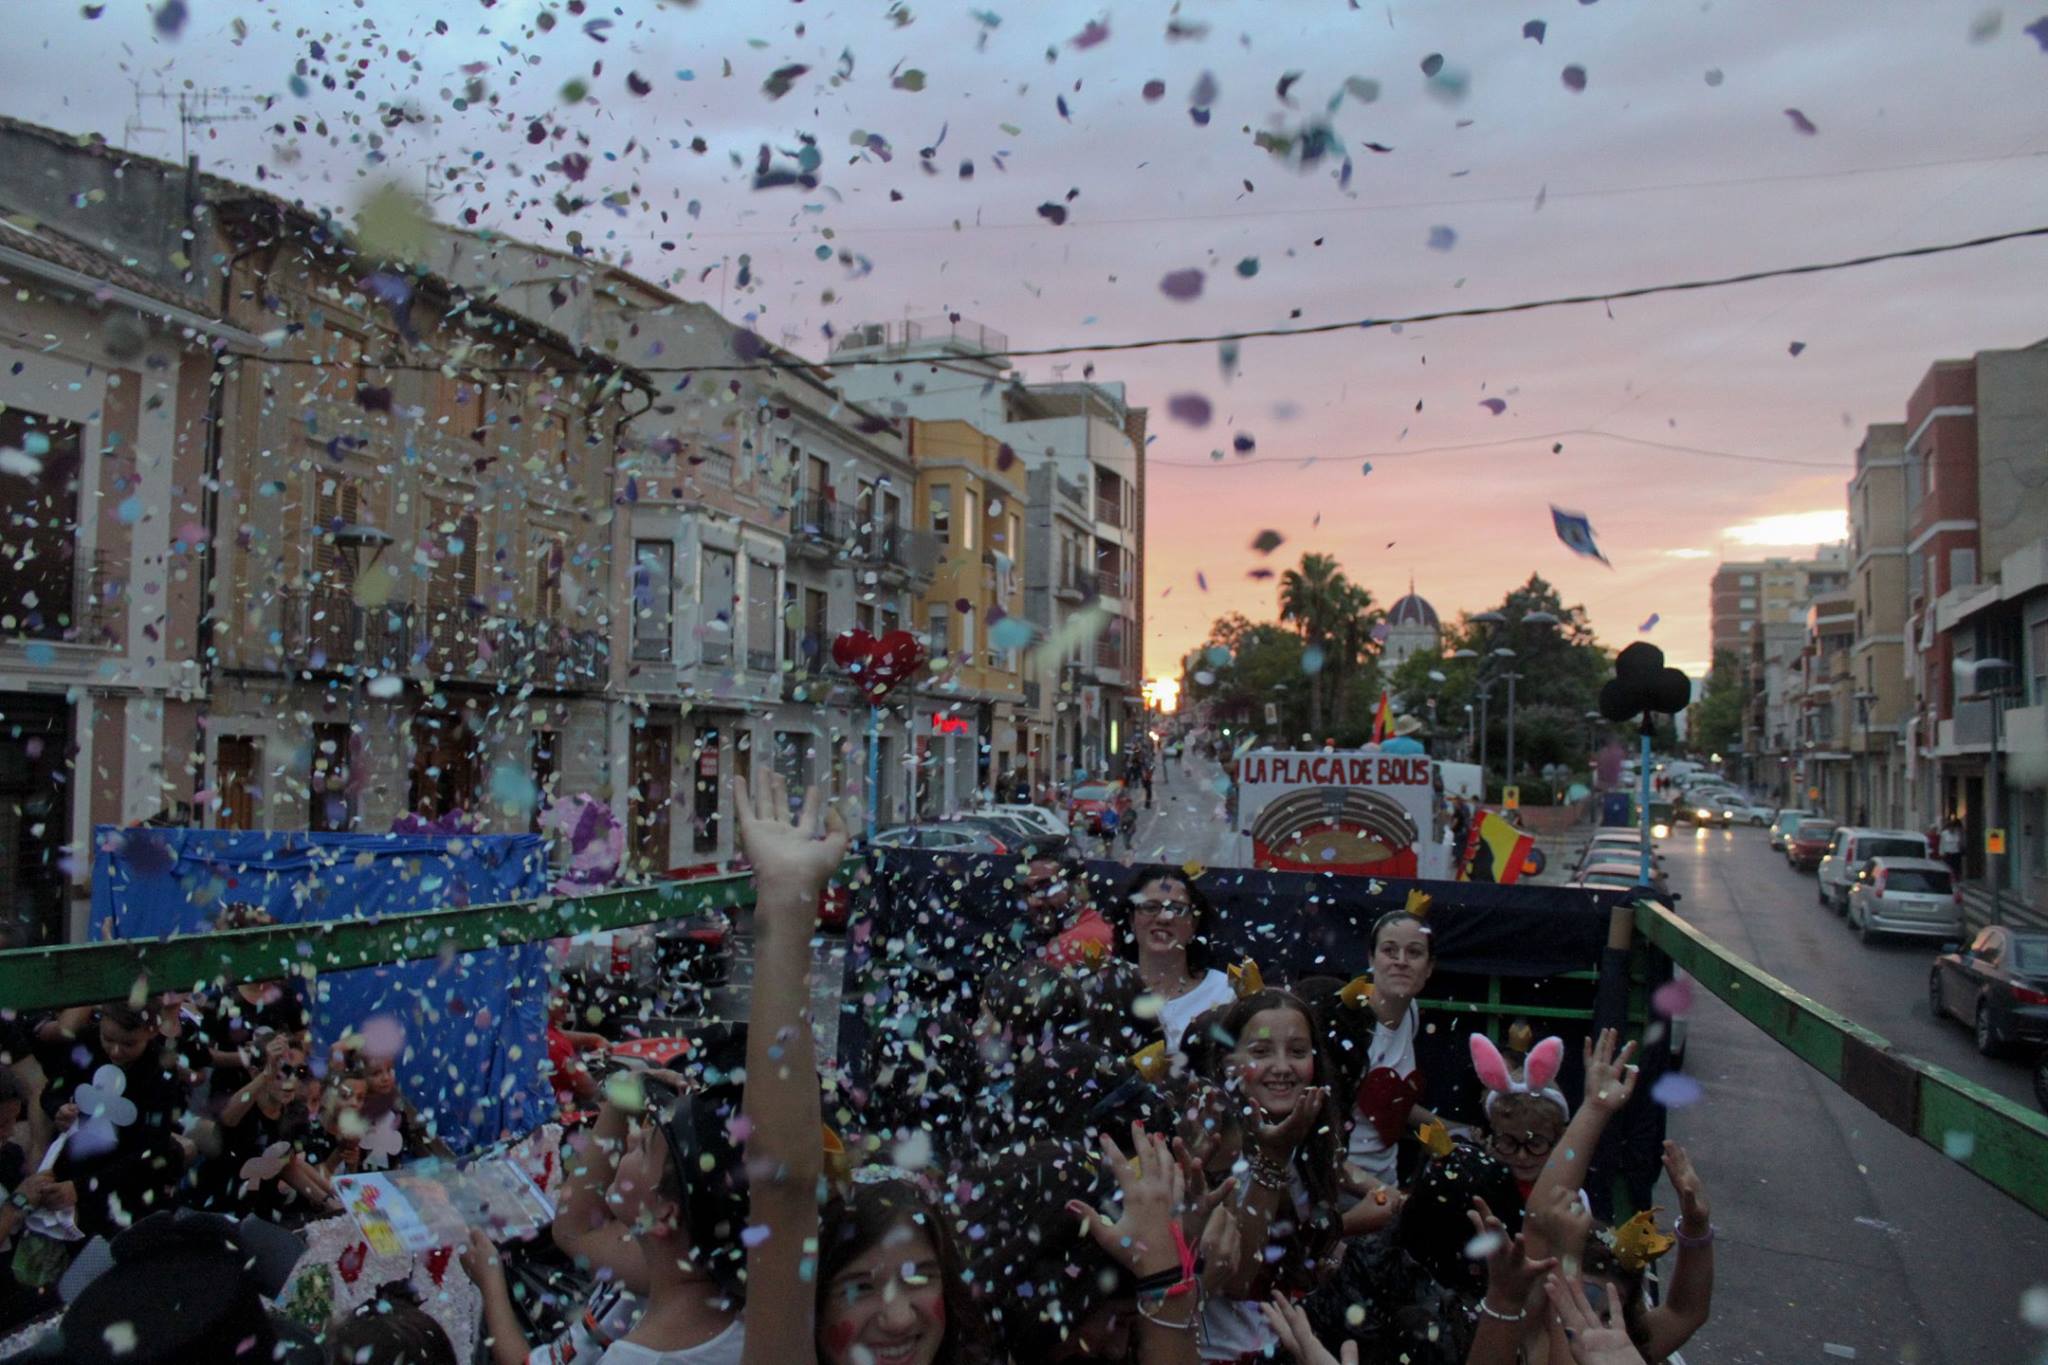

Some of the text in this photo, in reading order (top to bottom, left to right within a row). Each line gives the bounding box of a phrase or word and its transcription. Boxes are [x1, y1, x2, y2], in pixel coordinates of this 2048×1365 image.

[1245, 758, 1266, 783] LA
[1350, 758, 1372, 785] DE
[1378, 758, 1429, 785] BOUS
